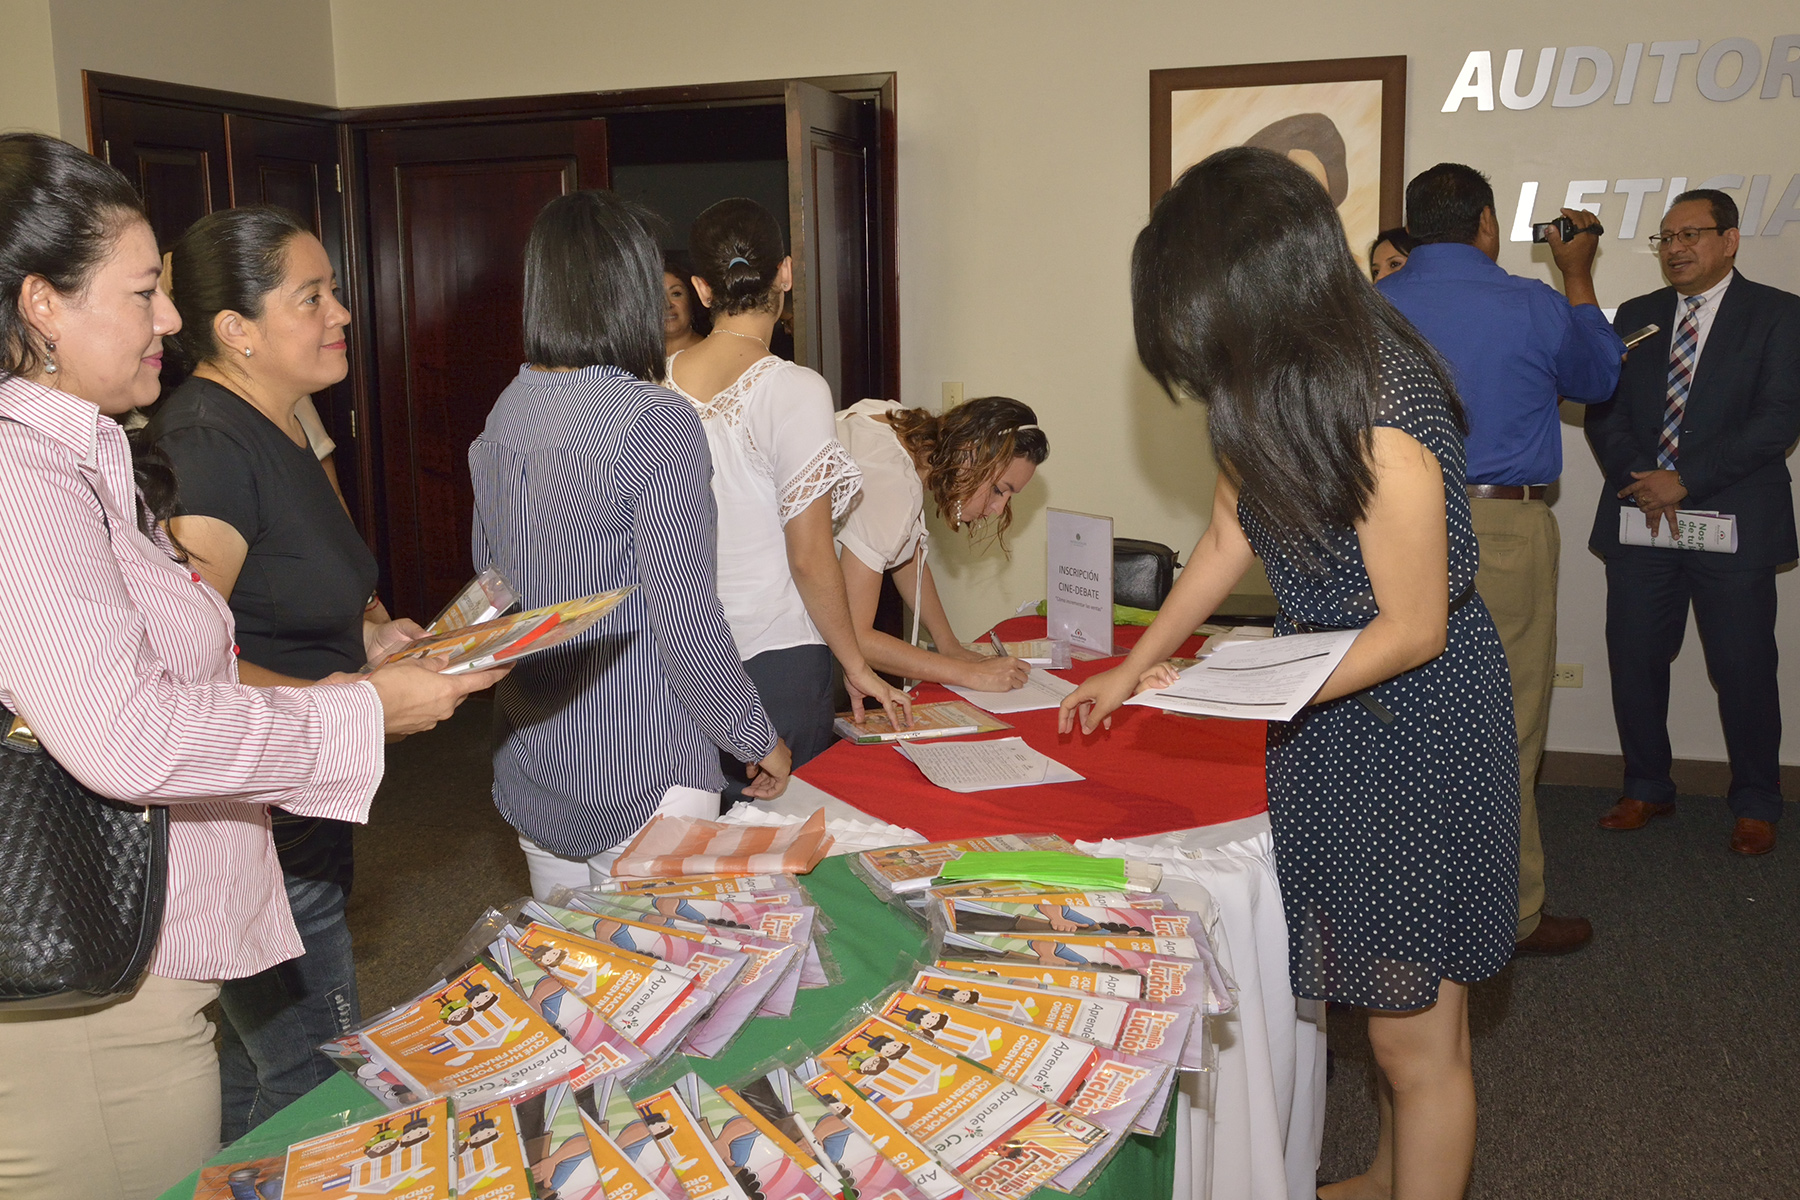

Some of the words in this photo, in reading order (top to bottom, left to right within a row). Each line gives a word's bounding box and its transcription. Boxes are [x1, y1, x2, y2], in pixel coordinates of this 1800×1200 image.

[1688, 521, 1695, 532] de
[1698, 523, 1706, 540] Nos
[1687, 535, 1694, 544] tu
[1058, 565, 1099, 582] INSCRIPCIÓN
[1058, 582, 1099, 600] CINE-DEBATE
[606, 968, 633, 995] ORDEN
[620, 971, 642, 994] ¿QUÉ
[1170, 968, 1184, 996] Familia
[602, 992, 624, 1014] HACE
[625, 974, 667, 1019] Aprende
[1045, 1000, 1061, 1024] ORDEN
[1080, 1002, 1102, 1040] Aprende
[1165, 1014, 1175, 1023] La
[506, 1030, 544, 1055] ORDEN
[522, 1035, 549, 1057] ¿QUÉ
[1145, 1019, 1165, 1050] Familia
[1003, 1033, 1028, 1062] ORDEN
[1019, 1037, 1040, 1062] ¿QUÉ
[437, 1051, 507, 1085] FINANCIERO?
[469, 1065, 492, 1079] POR
[492, 1052, 523, 1071] HACE
[510, 1043, 568, 1083] Aprende
[612, 1057, 626, 1068] La
[1005, 1056, 1025, 1079] HACE
[1033, 1040, 1069, 1084] Aprende
[457, 1073, 470, 1083] TI
[1133, 1070, 1145, 1079] La
[948, 1073, 982, 1100] ORDEN
[965, 1078, 991, 1102] ¿QUÉ
[1100, 1075, 1133, 1112] Familia
[944, 1095, 970, 1117] HACE
[969, 1084, 1018, 1129] Aprende
[924, 1113, 947, 1131] POR
[1064, 1120, 1086, 1133] 3
[1052, 1154, 1067, 1165] La
[999, 1158, 1051, 1195] Familia
